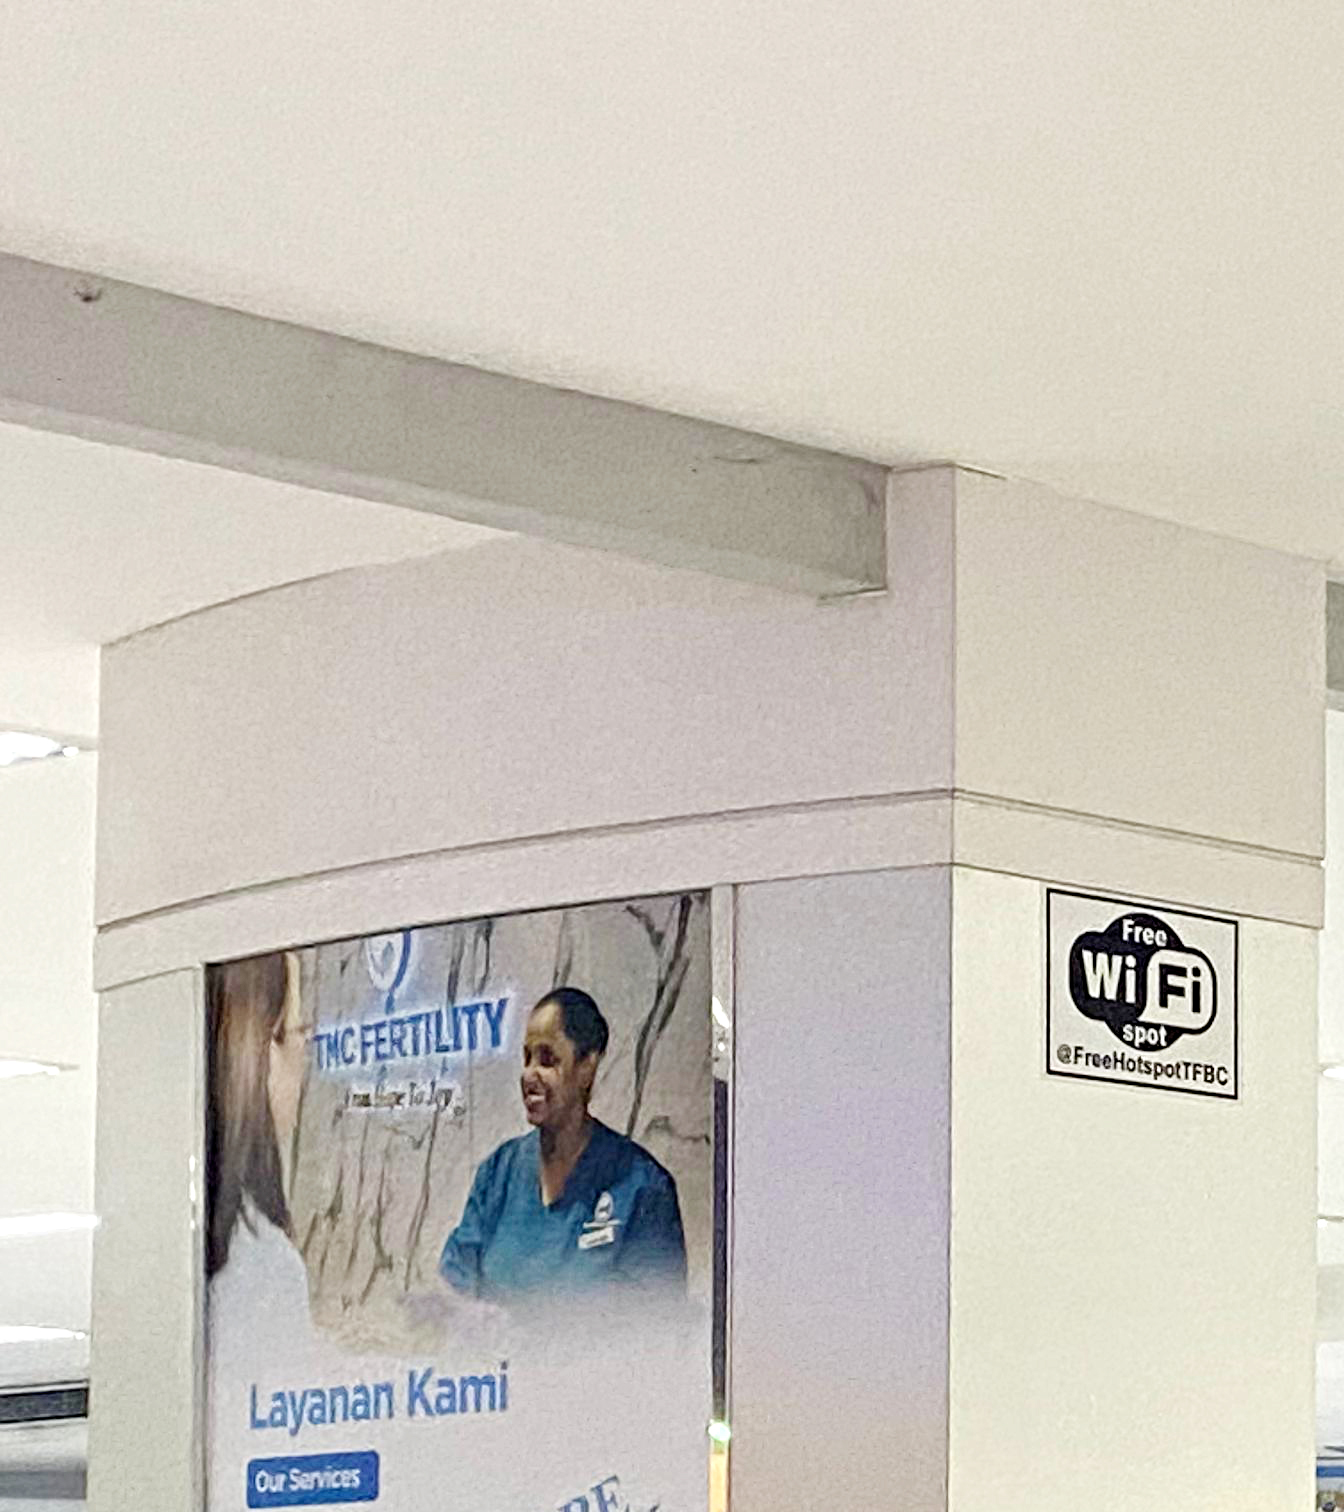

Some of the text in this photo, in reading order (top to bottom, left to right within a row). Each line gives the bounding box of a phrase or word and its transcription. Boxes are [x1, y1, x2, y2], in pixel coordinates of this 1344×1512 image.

[1122, 919, 1168, 946] Free
[313, 998, 508, 1071] TMC FERTILITY
[1123, 1025, 1167, 1048] spot
[1057, 1044, 1228, 1086] @FreeHotspotTFBC
[250, 1360, 509, 1437] Layanan Kami
[255, 1463, 361, 1494] Our Services
